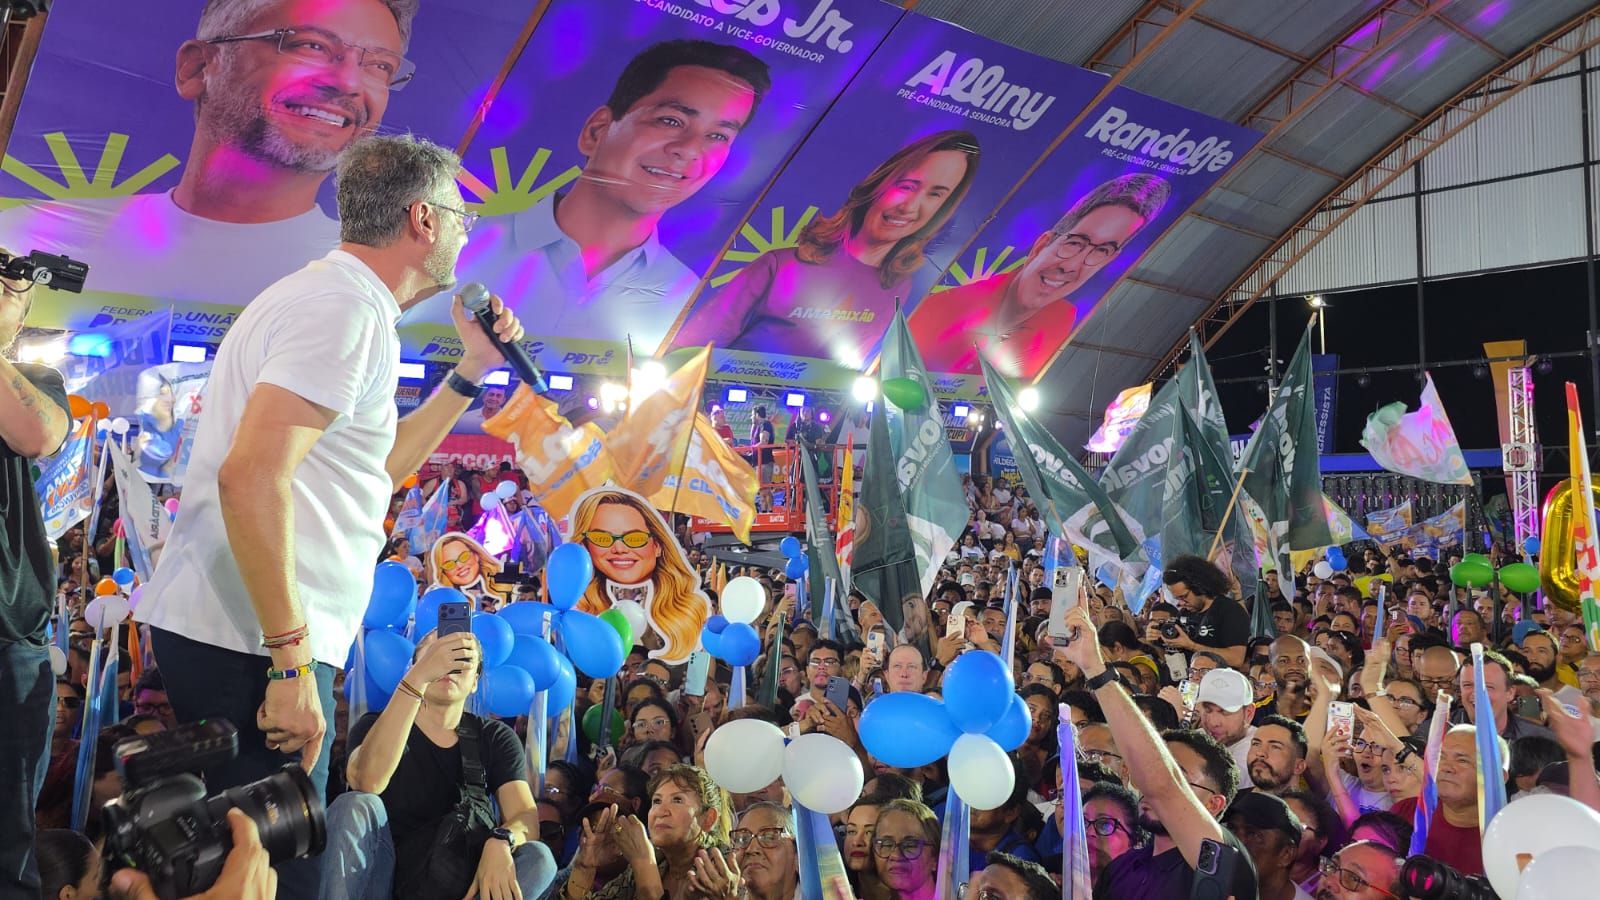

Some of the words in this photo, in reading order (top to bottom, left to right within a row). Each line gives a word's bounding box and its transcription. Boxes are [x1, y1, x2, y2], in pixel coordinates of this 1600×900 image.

[634, 0, 714, 27] -CANDIDATO
[714, 21, 725, 32] A
[726, 24, 825, 64] VICE-GOVERNADOR
[783, 0, 854, 54] Jr.
[896, 88, 963, 116] PRÉ-CANDIDATA
[962, 109, 970, 117] A
[969, 110, 1012, 129] SENADORA
[904, 50, 1057, 131] Alliny
[1084, 106, 1234, 176] Randolfe
[185, 311, 237, 326] UNIÃ
[562, 351, 600, 366] PDT
[715, 364, 801, 380] PROGRESSISTA
[1318, 386, 1332, 455] GRESSISTA
